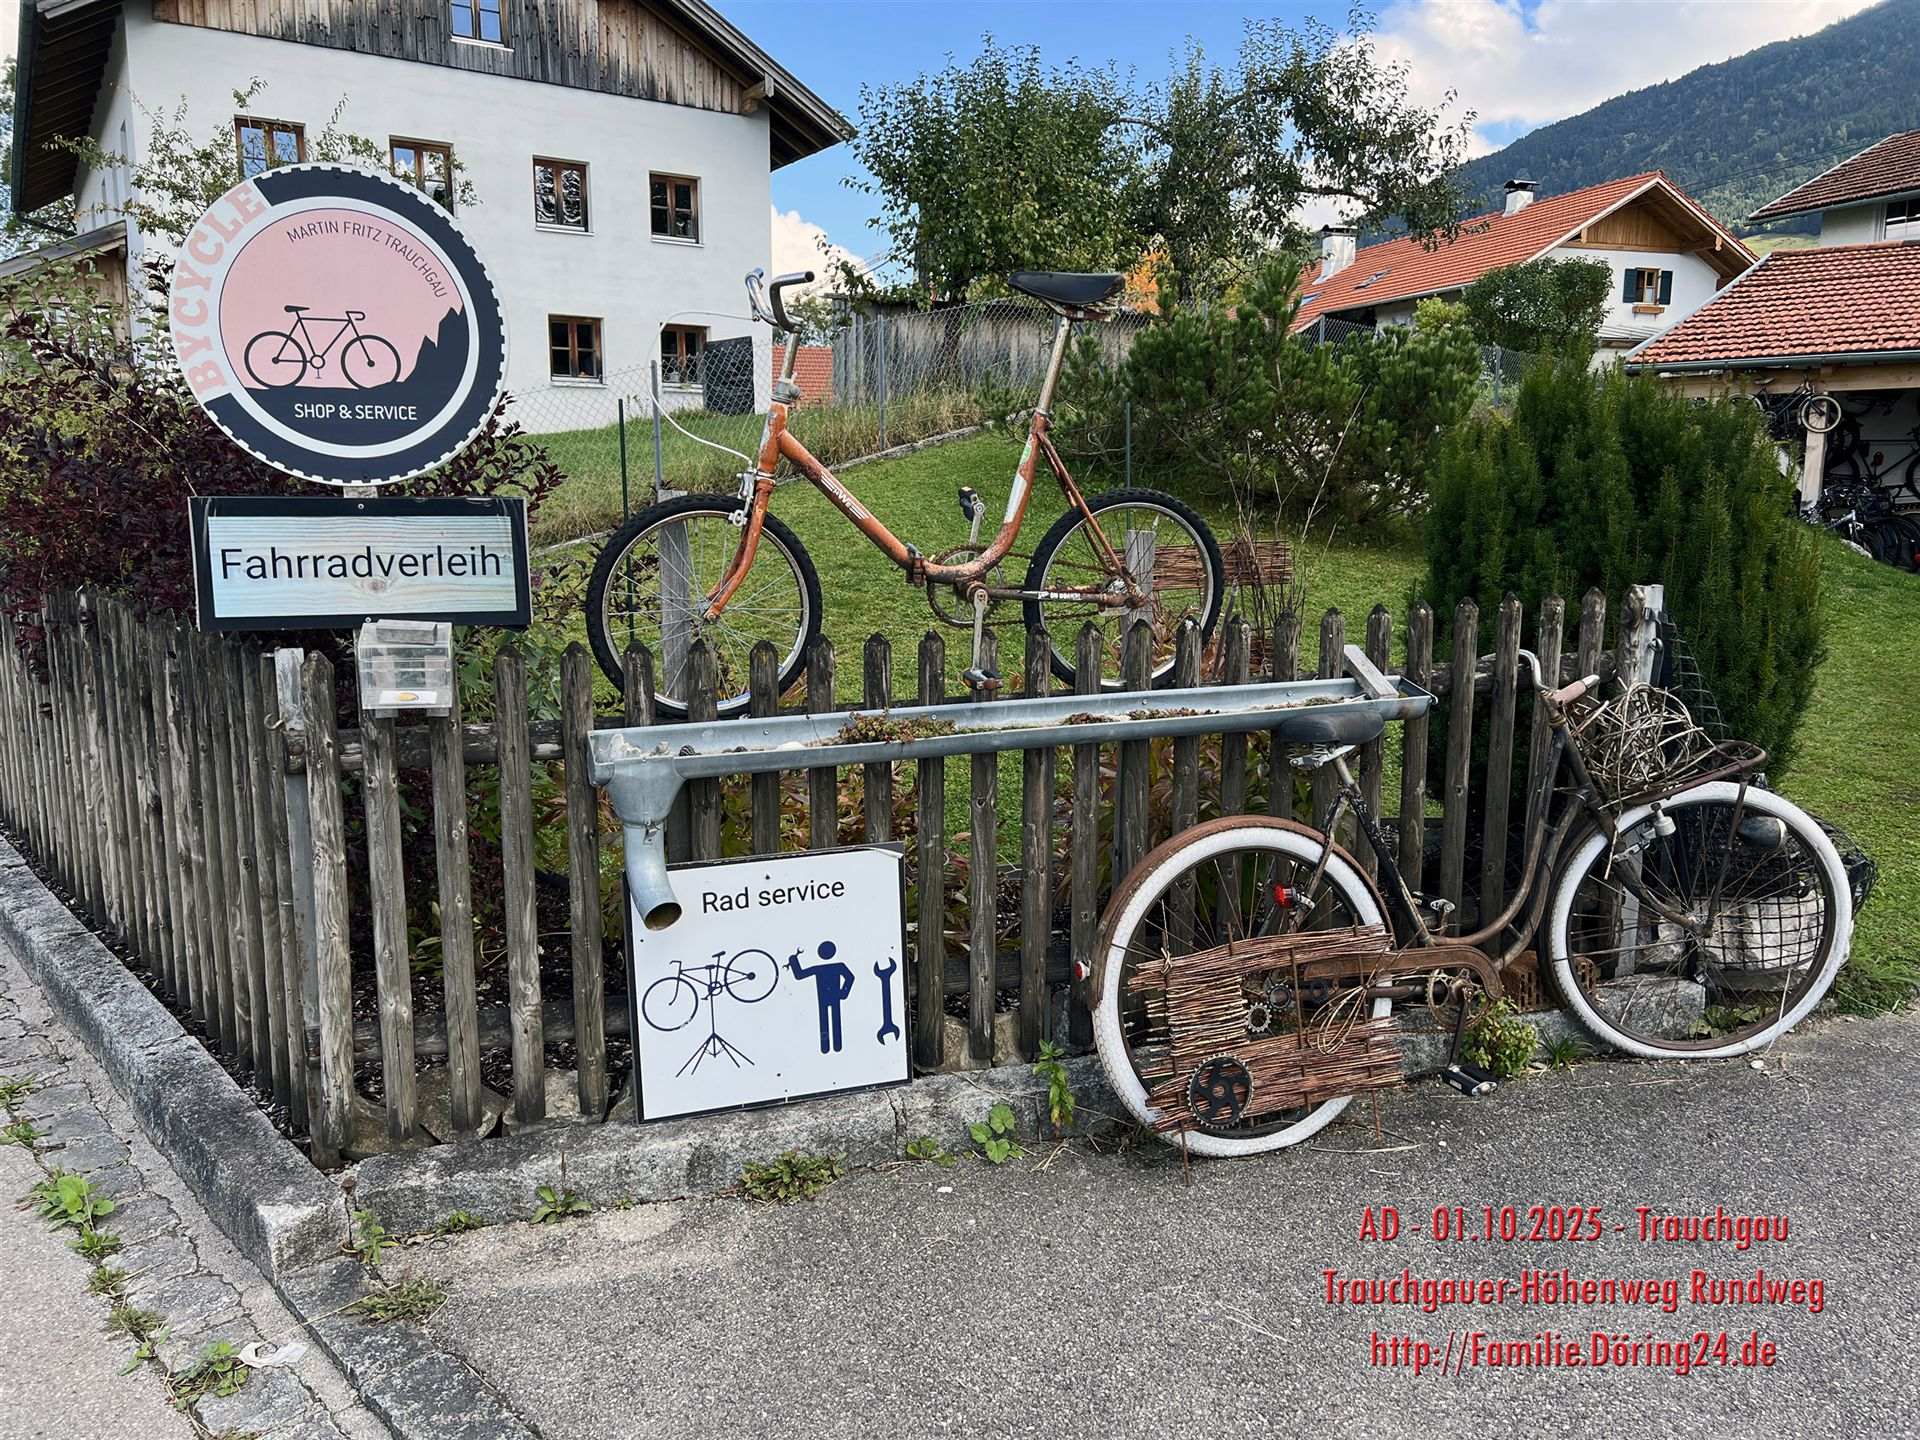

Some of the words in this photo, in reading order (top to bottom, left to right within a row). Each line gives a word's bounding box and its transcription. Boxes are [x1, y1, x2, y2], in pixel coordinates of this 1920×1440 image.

[286, 220, 340, 243] MARTIN
[342, 220, 383, 243] FRITZ
[384, 232, 448, 299] TRAUCHGAU
[174, 182, 269, 396] BYCYCLE
[294, 403, 336, 419] SHOP
[338, 404, 353, 420] &
[354, 404, 418, 421] SERVICE
[220, 544, 502, 580] Fahrradverleih
[702, 886, 749, 914] Rad
[758, 879, 845, 907] service
